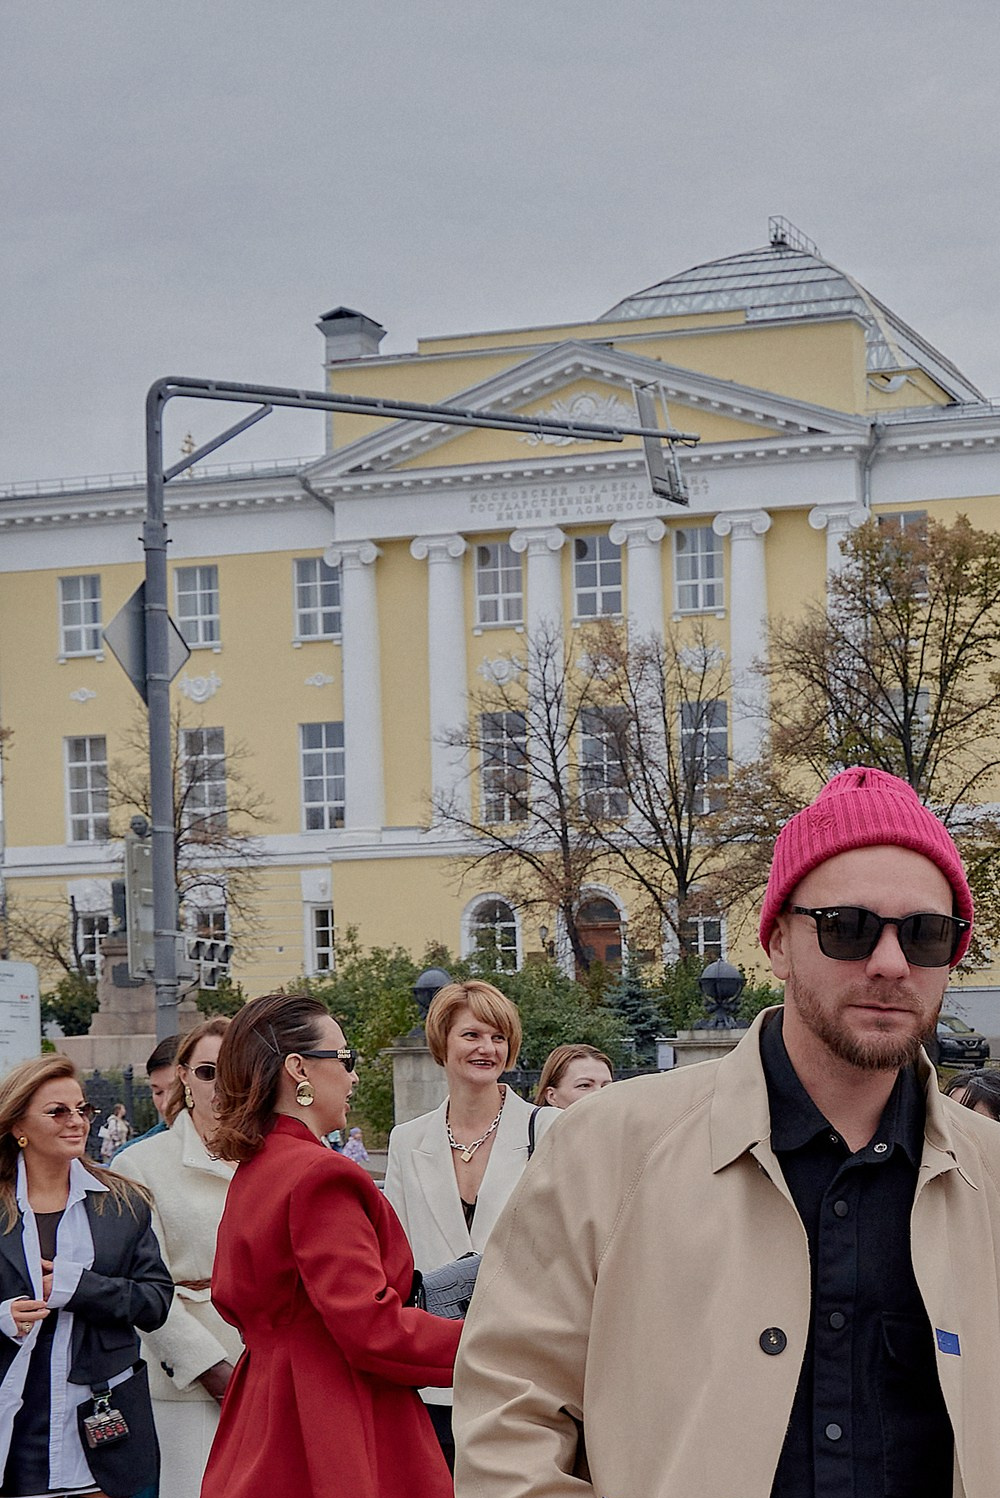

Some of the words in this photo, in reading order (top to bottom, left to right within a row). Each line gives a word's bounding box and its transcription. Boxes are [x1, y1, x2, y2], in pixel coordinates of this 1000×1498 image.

[470, 486, 568, 503] МОСКОВСКИЙ
[579, 481, 638, 494] ОРДЕНА
[470, 493, 601, 513] ГОСУДАРСТВЕННЫЙ
[496, 509, 542, 521] ИМЕНИ
[576, 500, 673, 516] ЛОМОНОСОВА
